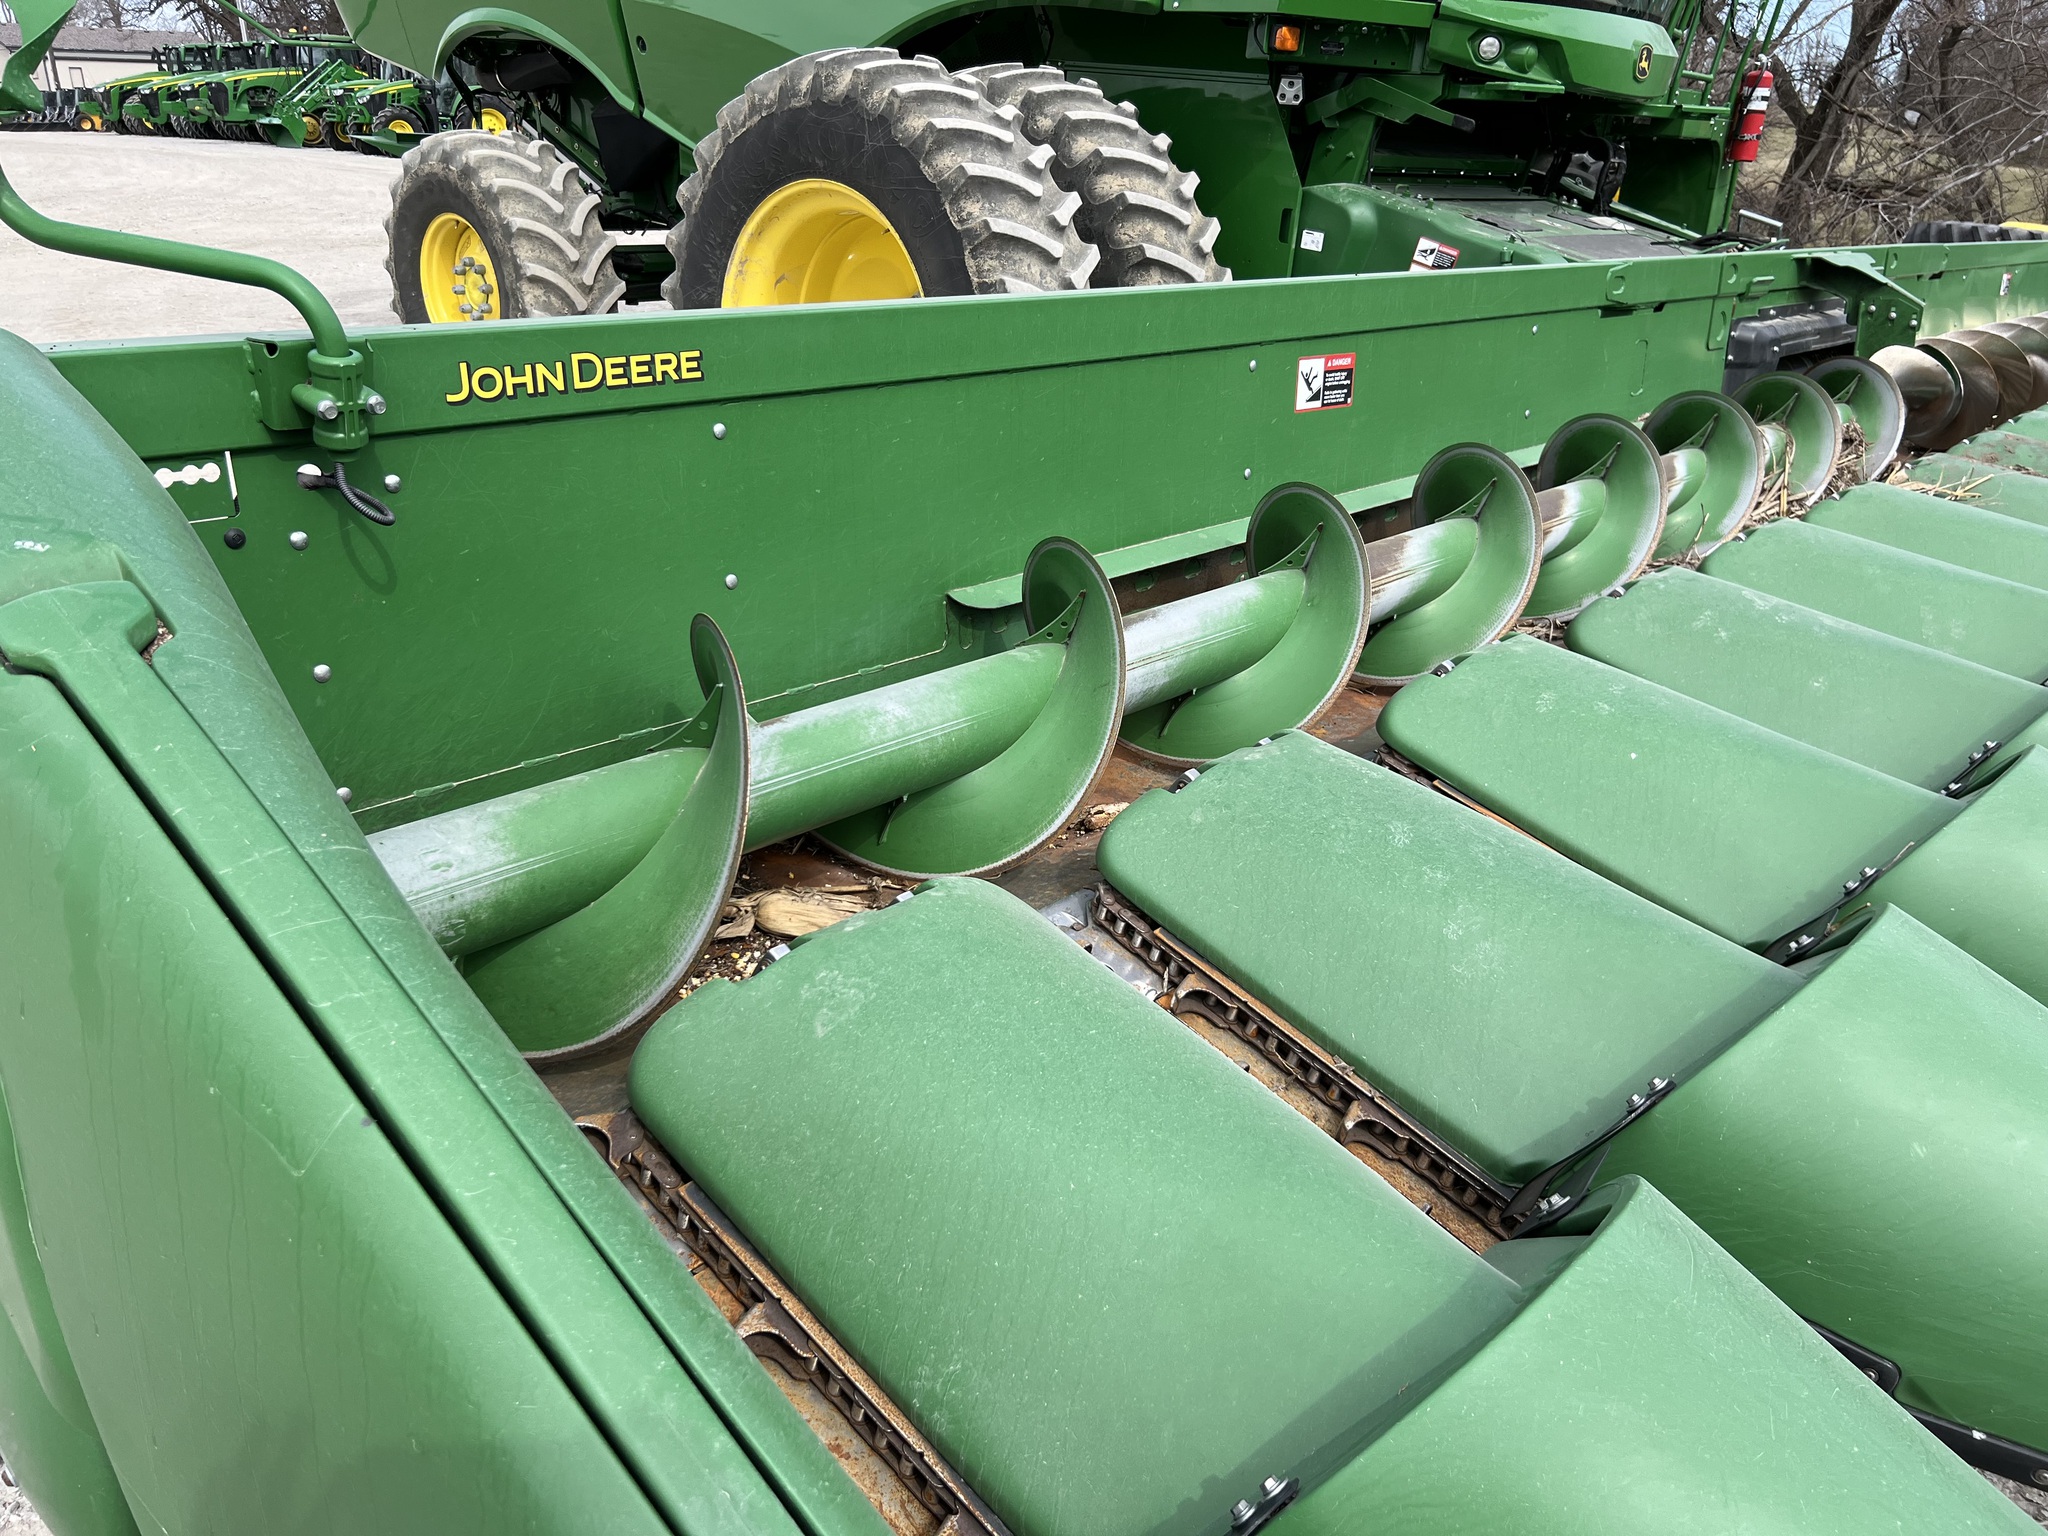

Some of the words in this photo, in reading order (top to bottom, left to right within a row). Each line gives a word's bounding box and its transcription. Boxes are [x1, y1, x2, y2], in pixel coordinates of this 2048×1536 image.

[446, 361, 567, 405] JOHN
[570, 350, 704, 393] DEERE
[1332, 357, 1352, 366] DANGER
